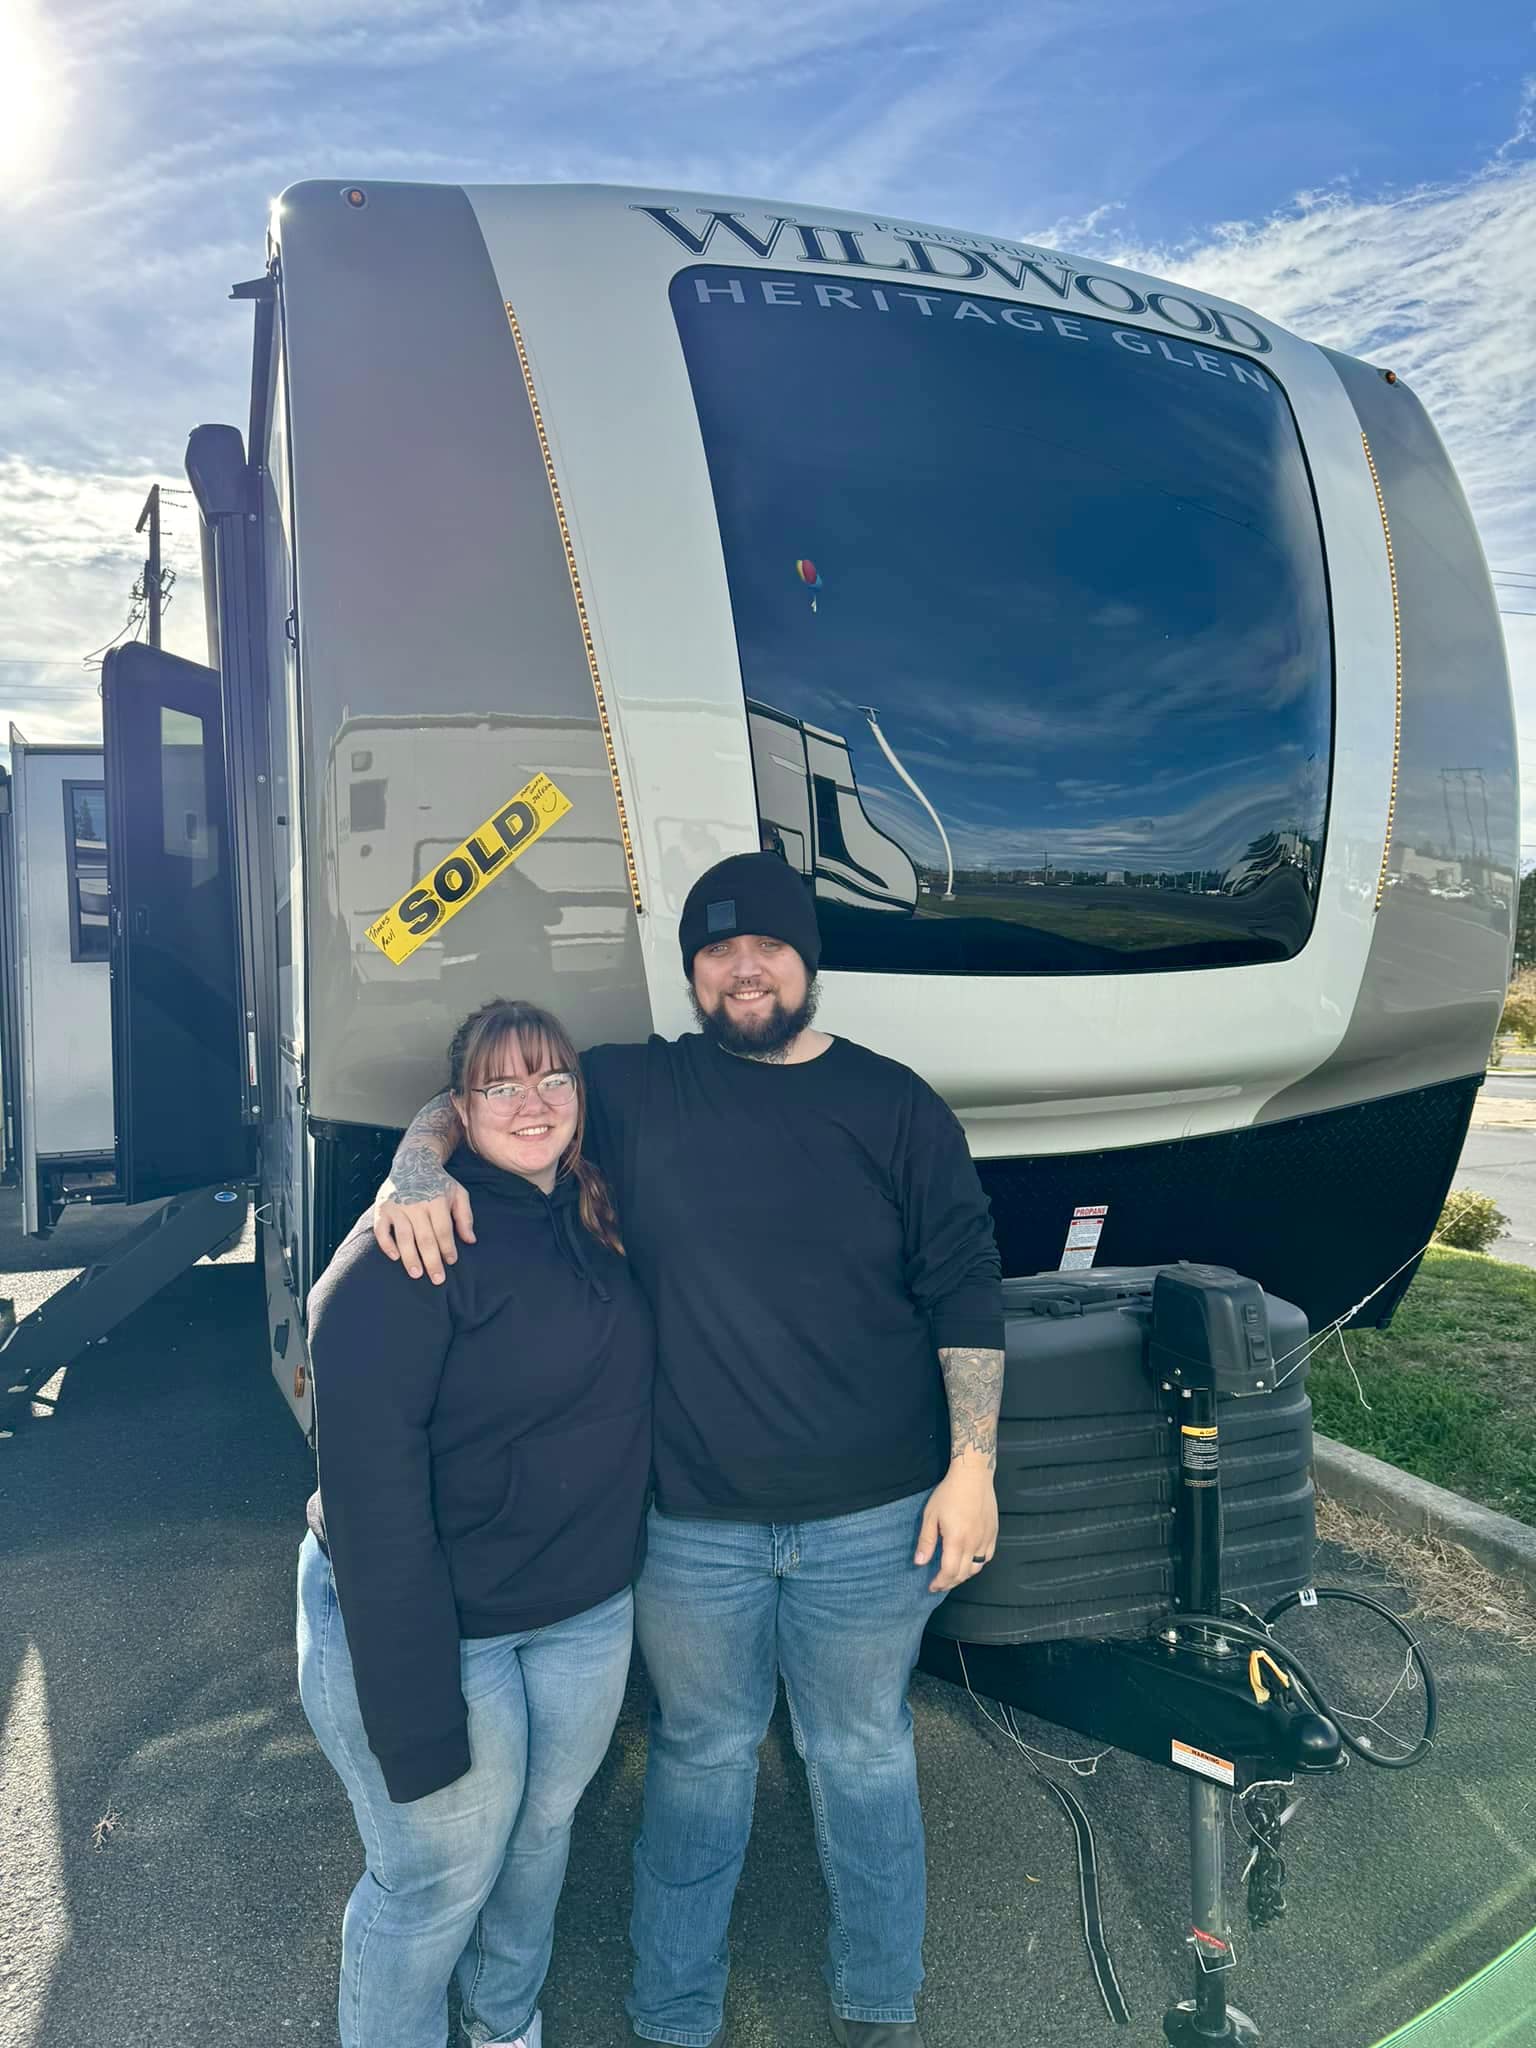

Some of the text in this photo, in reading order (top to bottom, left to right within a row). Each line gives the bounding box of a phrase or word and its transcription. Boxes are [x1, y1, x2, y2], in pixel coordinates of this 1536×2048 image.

[631, 206, 1273, 353] WILDWOOD
[872, 222, 1075, 267] FOREST RIVER
[694, 279, 1270, 392] HERITAGE GLEN
[398, 800, 541, 936] SOLD
[1191, 1749, 1220, 1765] WARNING
